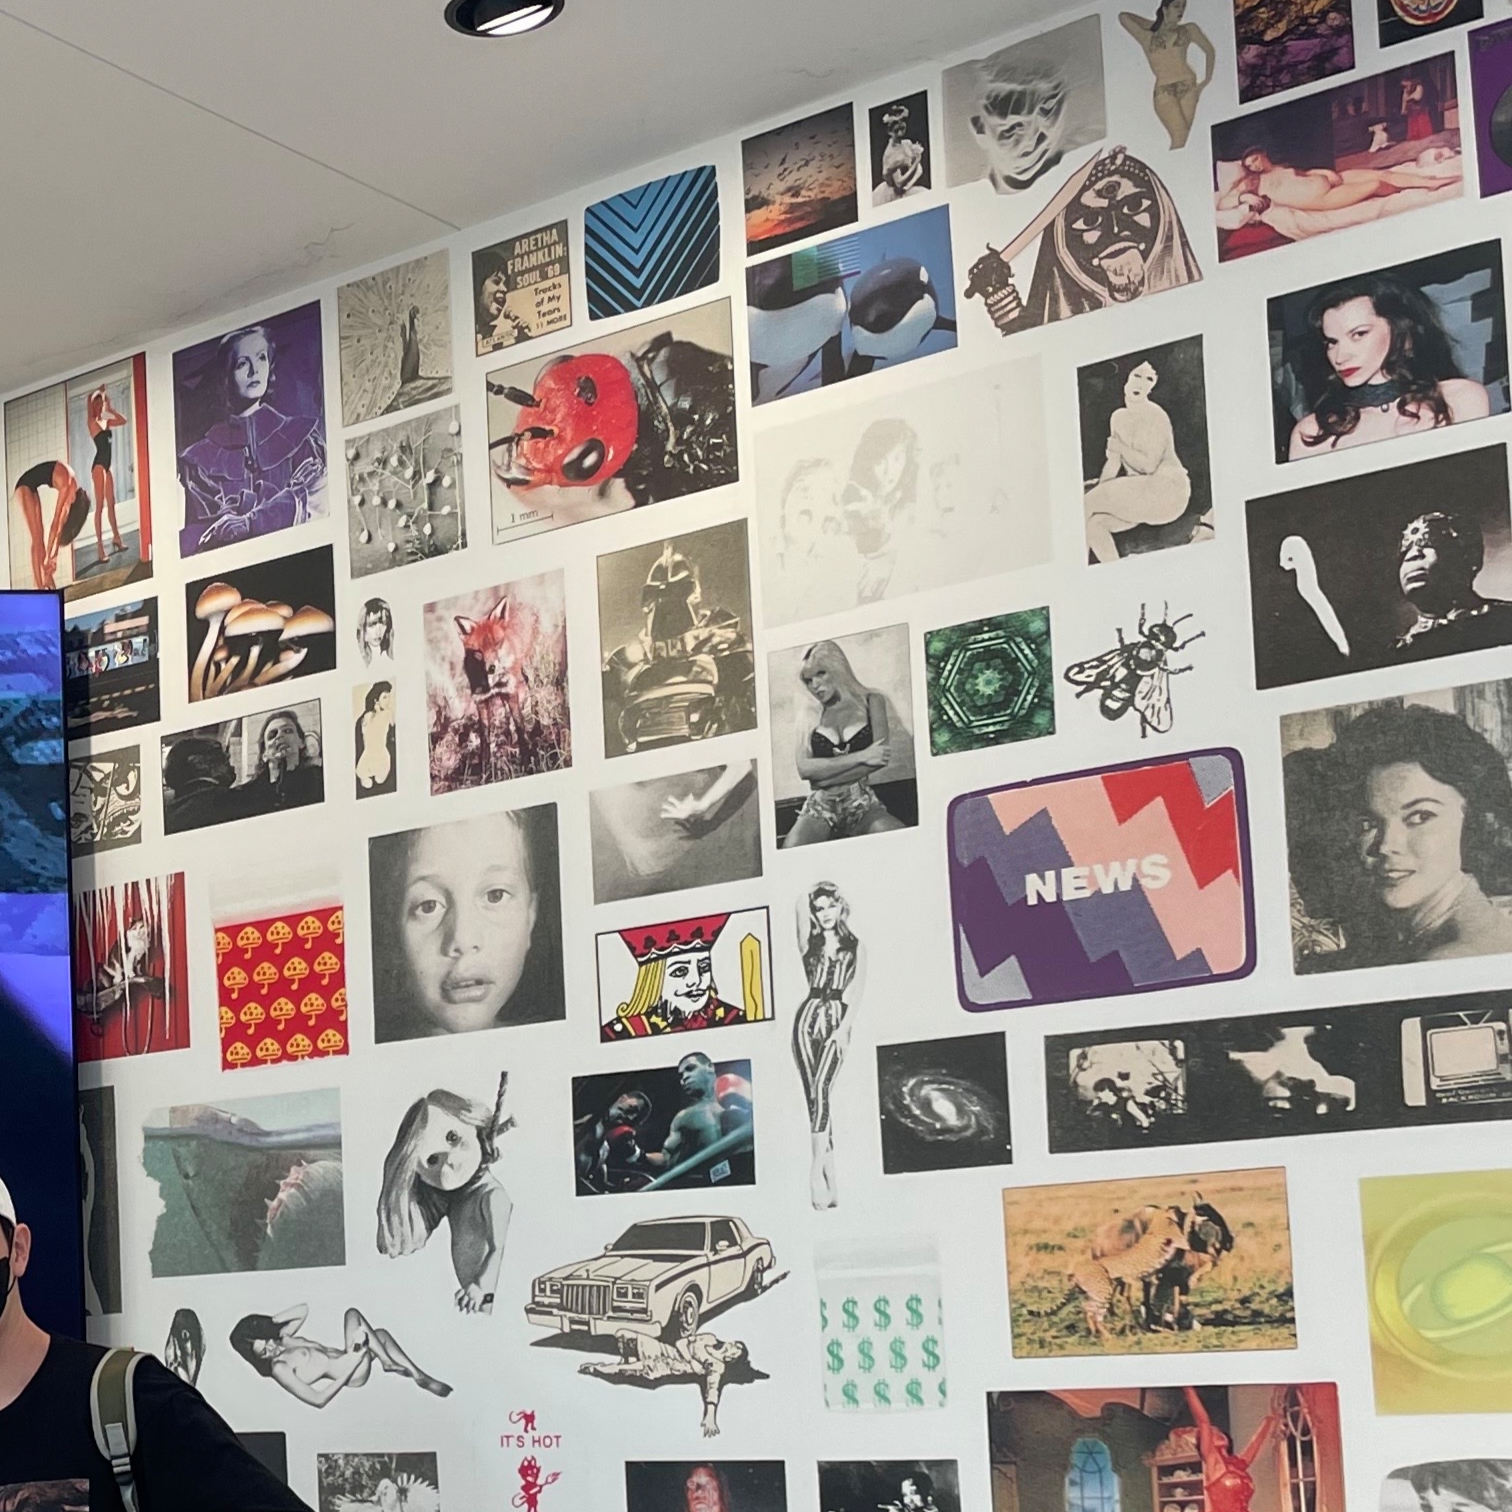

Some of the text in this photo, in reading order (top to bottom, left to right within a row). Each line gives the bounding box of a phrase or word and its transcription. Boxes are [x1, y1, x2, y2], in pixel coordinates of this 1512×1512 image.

[514, 228, 559, 256] ARETHA
[516, 270, 541, 289] SOUL
[534, 282, 562, 297] Tracks
[535, 294, 561, 309] of My
[537, 307, 561, 320] Tears
[519, 509, 538, 520] mm
[1025, 853, 1172, 906] NEWS
[500, 1435, 562, 1448] IT'S HOT
